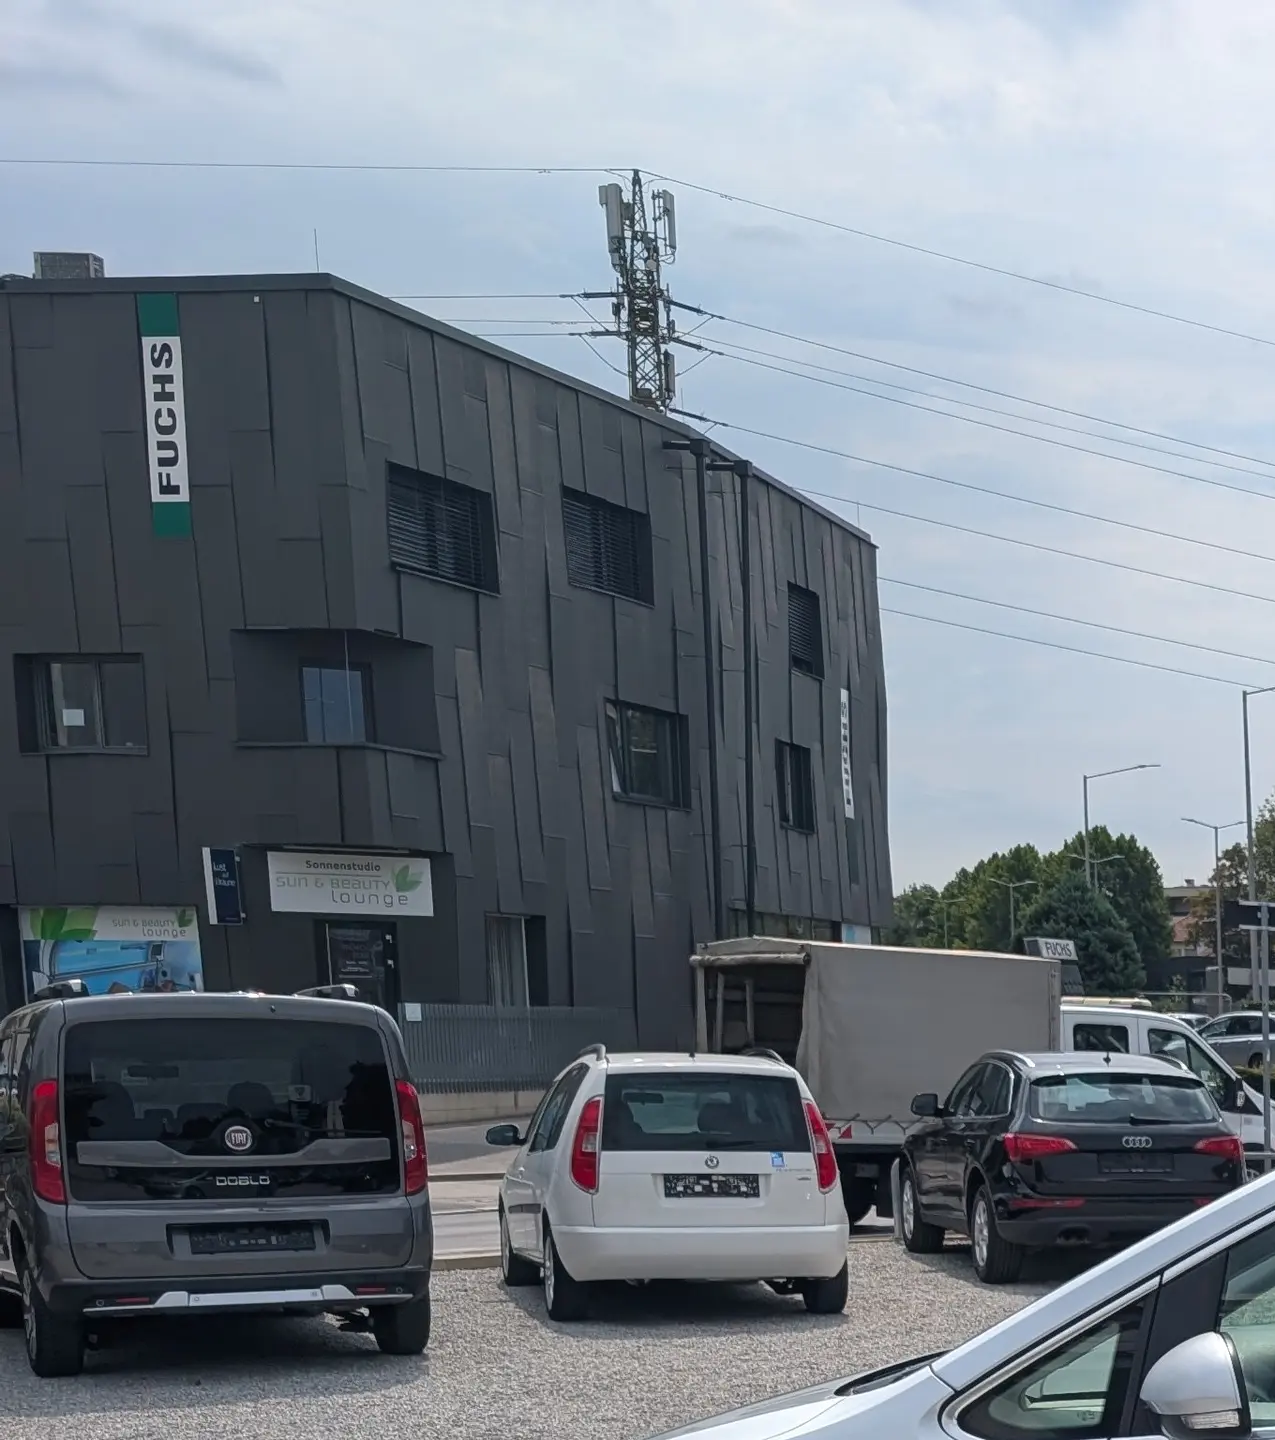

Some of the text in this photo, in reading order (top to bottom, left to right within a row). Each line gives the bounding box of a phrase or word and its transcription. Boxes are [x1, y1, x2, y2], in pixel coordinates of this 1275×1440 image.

[150, 342, 181, 495] FUCHS
[305, 860, 381, 872] Sonnenstudio
[314, 877, 325, 888] &
[331, 890, 409, 908] lounge
[142, 928, 187, 939] lounge
[1044, 942, 1073, 957] FUCHS
[231, 1132, 247, 1144] FIAT
[216, 1175, 270, 1186] DOBLO
